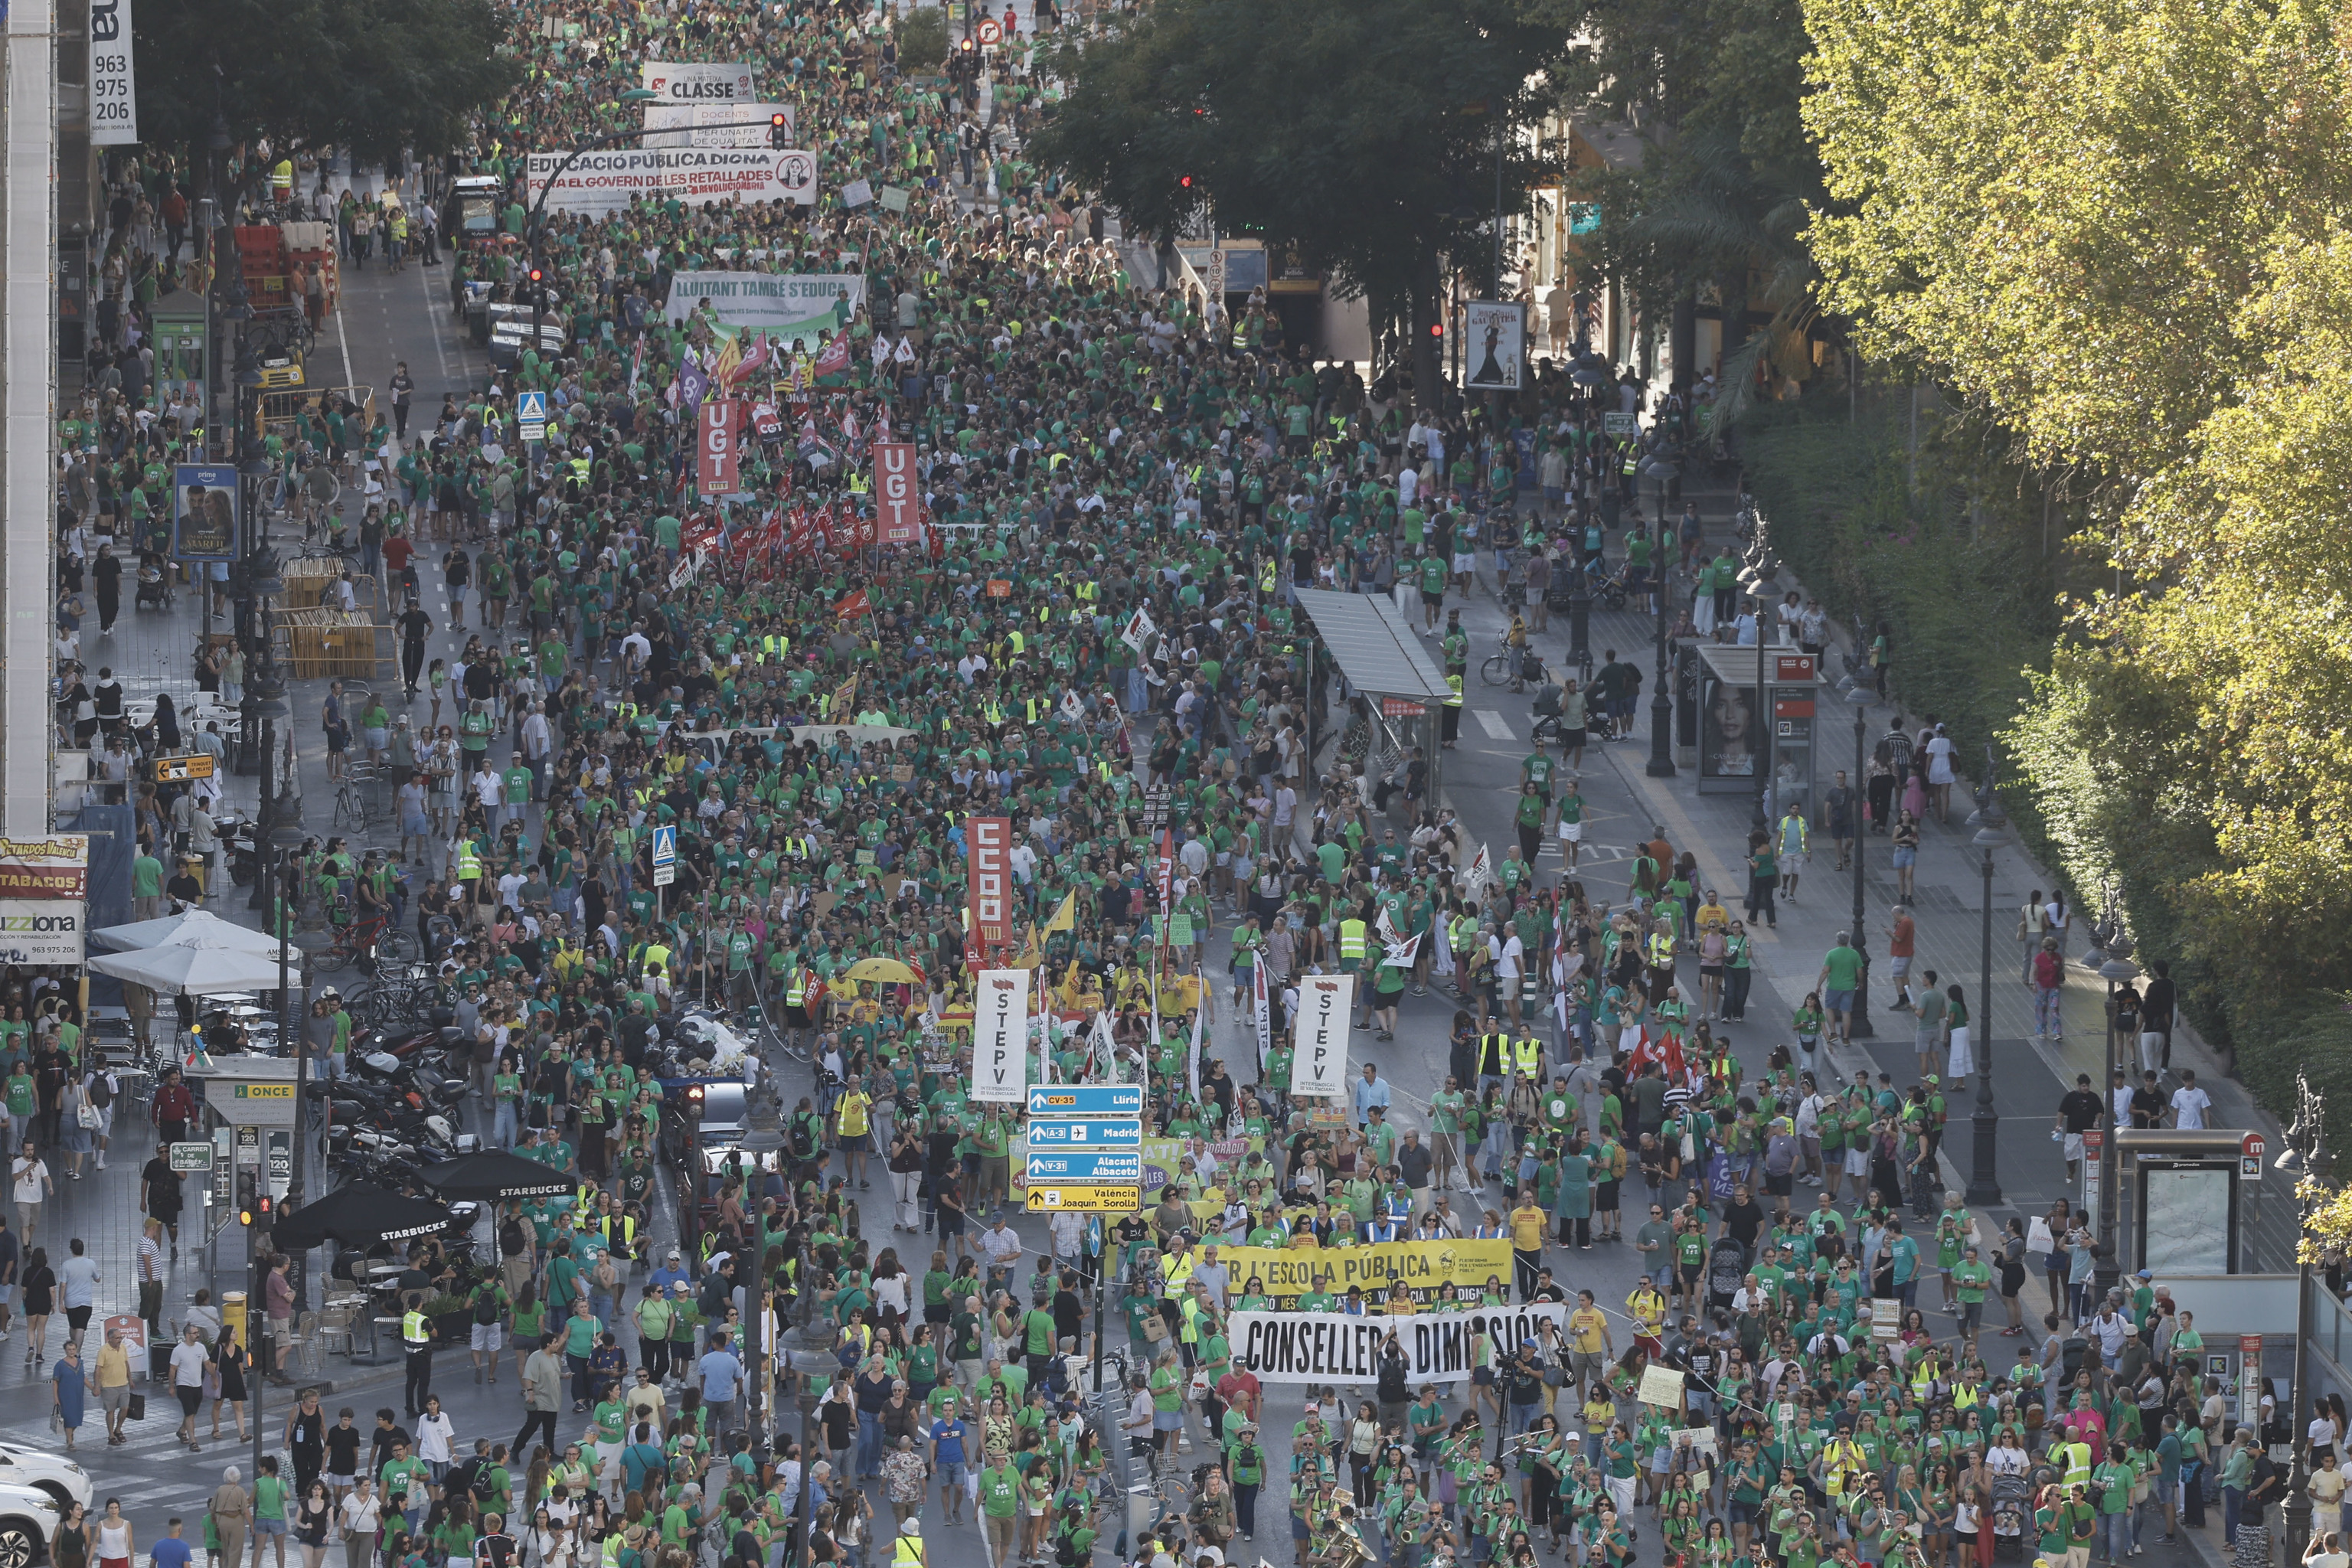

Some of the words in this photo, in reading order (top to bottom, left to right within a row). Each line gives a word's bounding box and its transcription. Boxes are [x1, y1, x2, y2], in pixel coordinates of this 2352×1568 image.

[95, 56, 126, 73] 963
[96, 79, 128, 96] 975
[671, 82, 733, 99] CLASSE
[96, 103, 129, 120] 206
[701, 110, 750, 119] DOCENTS
[629, 152, 707, 170] PÚBLICA
[710, 153, 770, 165] DIGNA
[568, 178, 584, 188] EL
[585, 175, 644, 188] GOVERN
[645, 175, 663, 187] DE
[665, 173, 688, 186] LES
[689, 169, 774, 185] RETALLADES
[676, 281, 739, 298] LLUITANT
[741, 279, 786, 298] TAMBÉ
[789, 281, 846, 298] S'EDUCA
[760, 422, 782, 434] CGT
[708, 403, 728, 477] UGT
[884, 449, 906, 524] UGT
[977, 823, 1001, 921] CCOO
[0, 874, 77, 889] TABACOS
[993, 993, 1009, 1086] STEPV
[1312, 994, 1331, 1081] STEPV
[252, 1087, 289, 1096] ONCE
[1112, 1096, 1139, 1105] Llíria
[1049, 1129, 1064, 1137] A-3
[1103, 1129, 1139, 1138] Madrid
[2249, 1142, 2265, 1153] m
[270, 1160, 289, 1169] 120
[1047, 1162, 1066, 1171] V-31
[1097, 1157, 1138, 1166] Alacant
[1092, 1167, 1138, 1176] Albacete
[499, 1185, 567, 1196] STARBUCKS
[1094, 1189, 1136, 1198] València
[1063, 1199, 1097, 1209] Joaquín
[381, 1220, 447, 1240] STARBUCKS
[1344, 1251, 1430, 1282] PÚBLICA
[1281, 1295, 1295, 1311] MÉS
